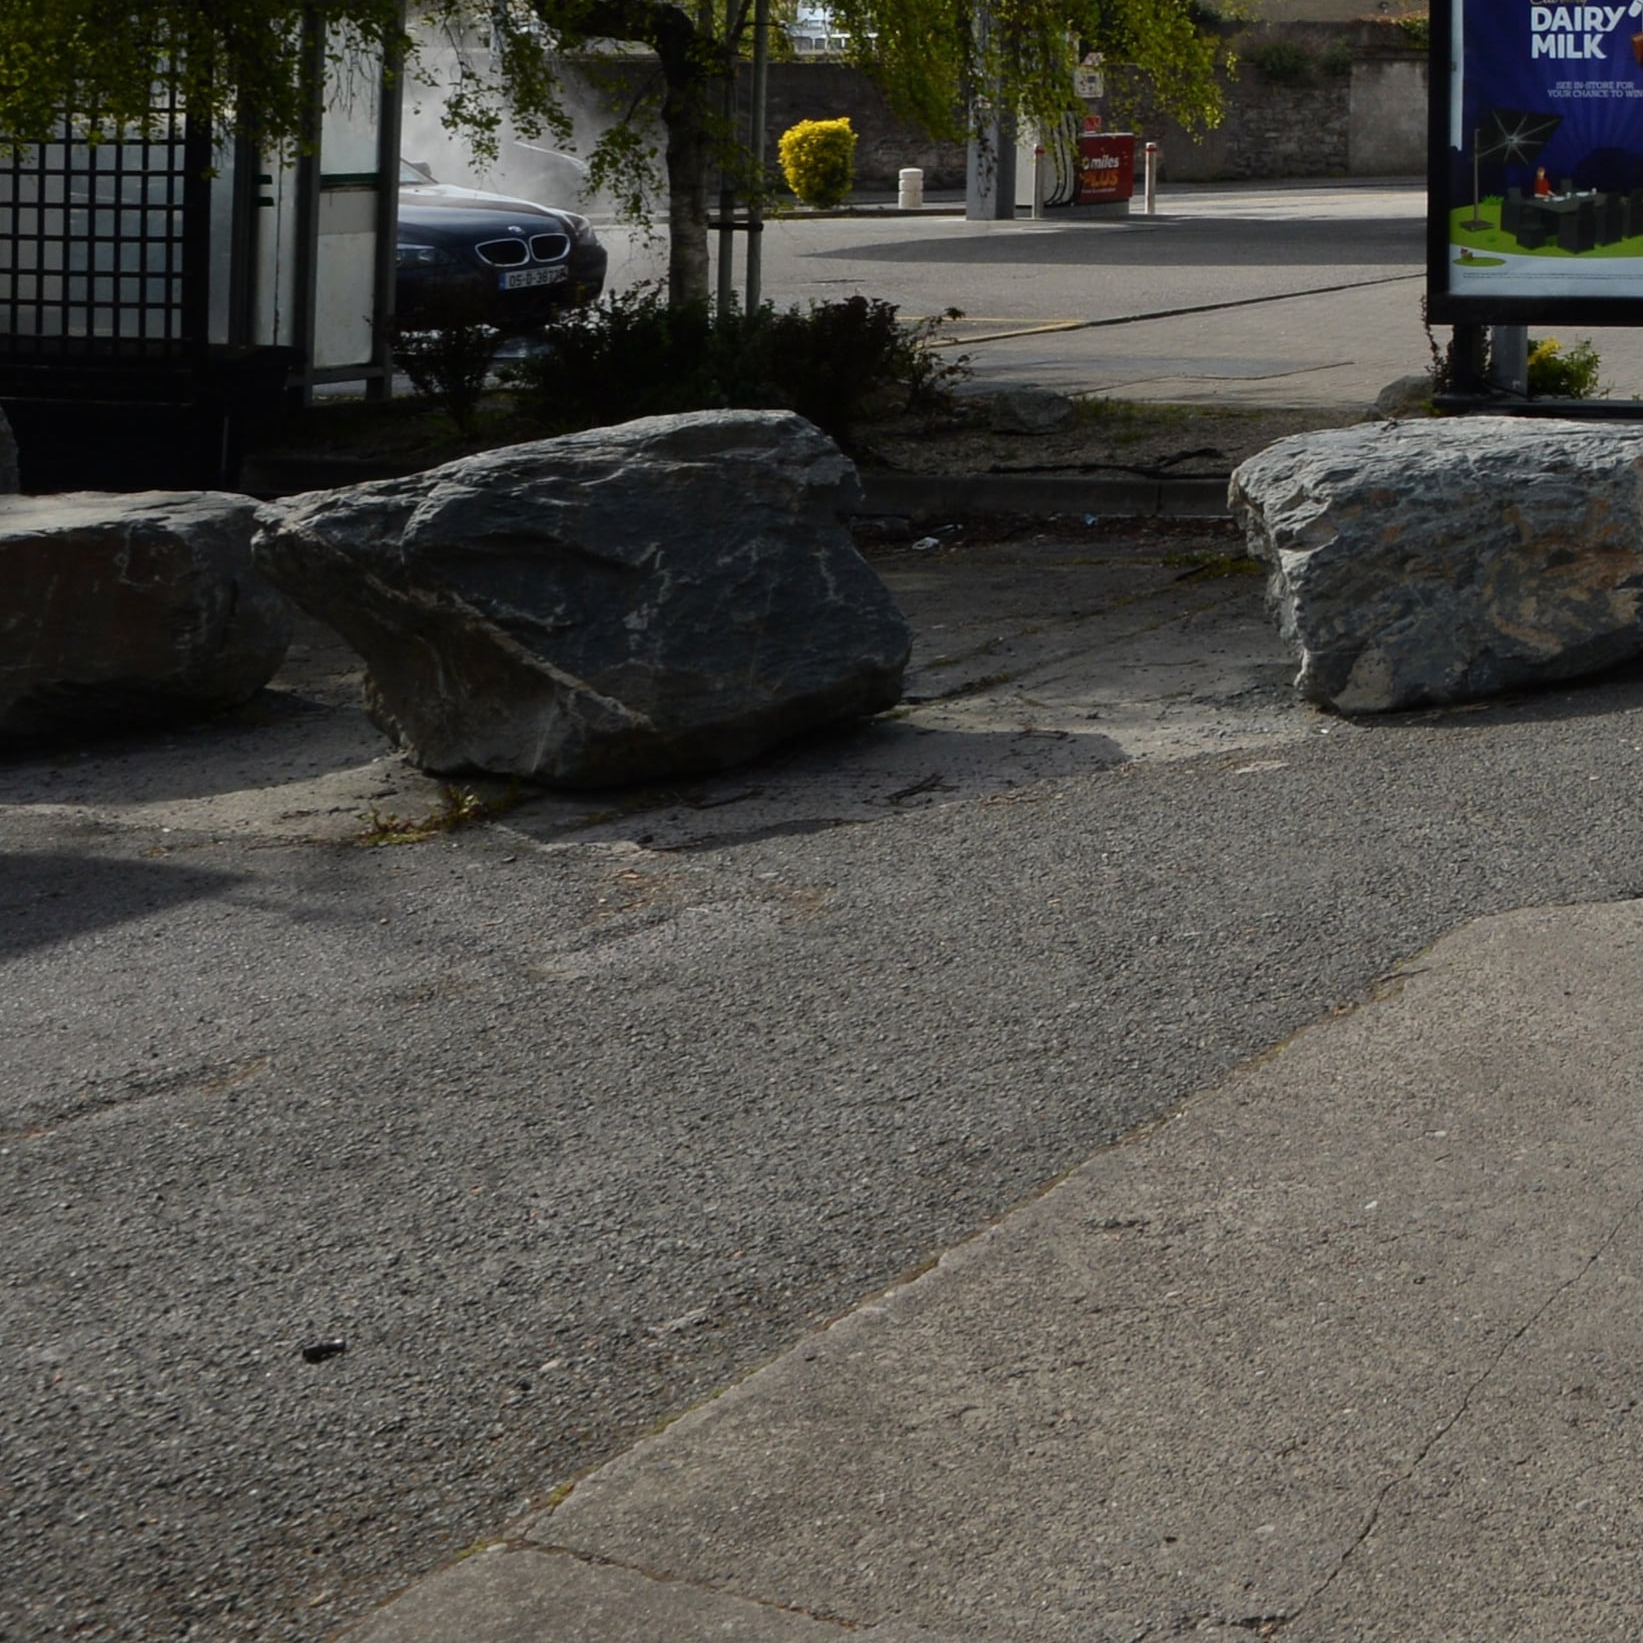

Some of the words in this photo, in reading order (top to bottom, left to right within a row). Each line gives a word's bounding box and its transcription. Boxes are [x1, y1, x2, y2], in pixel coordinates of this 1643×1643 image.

[1531, 6, 1626, 32] DAIRY
[1531, 34, 1608, 59] MILK
[1556, 82, 1572, 90] SEE
[1574, 82, 1615, 90] IN-STORE
[1616, 82, 1634, 90] FOR
[1547, 90, 1571, 98] YOUR
[1573, 90, 1609, 98] CHANCE
[1611, 90, 1623, 98] TO
[1625, 90, 1643, 98] WIN
[1091, 155, 1119, 169] miles
